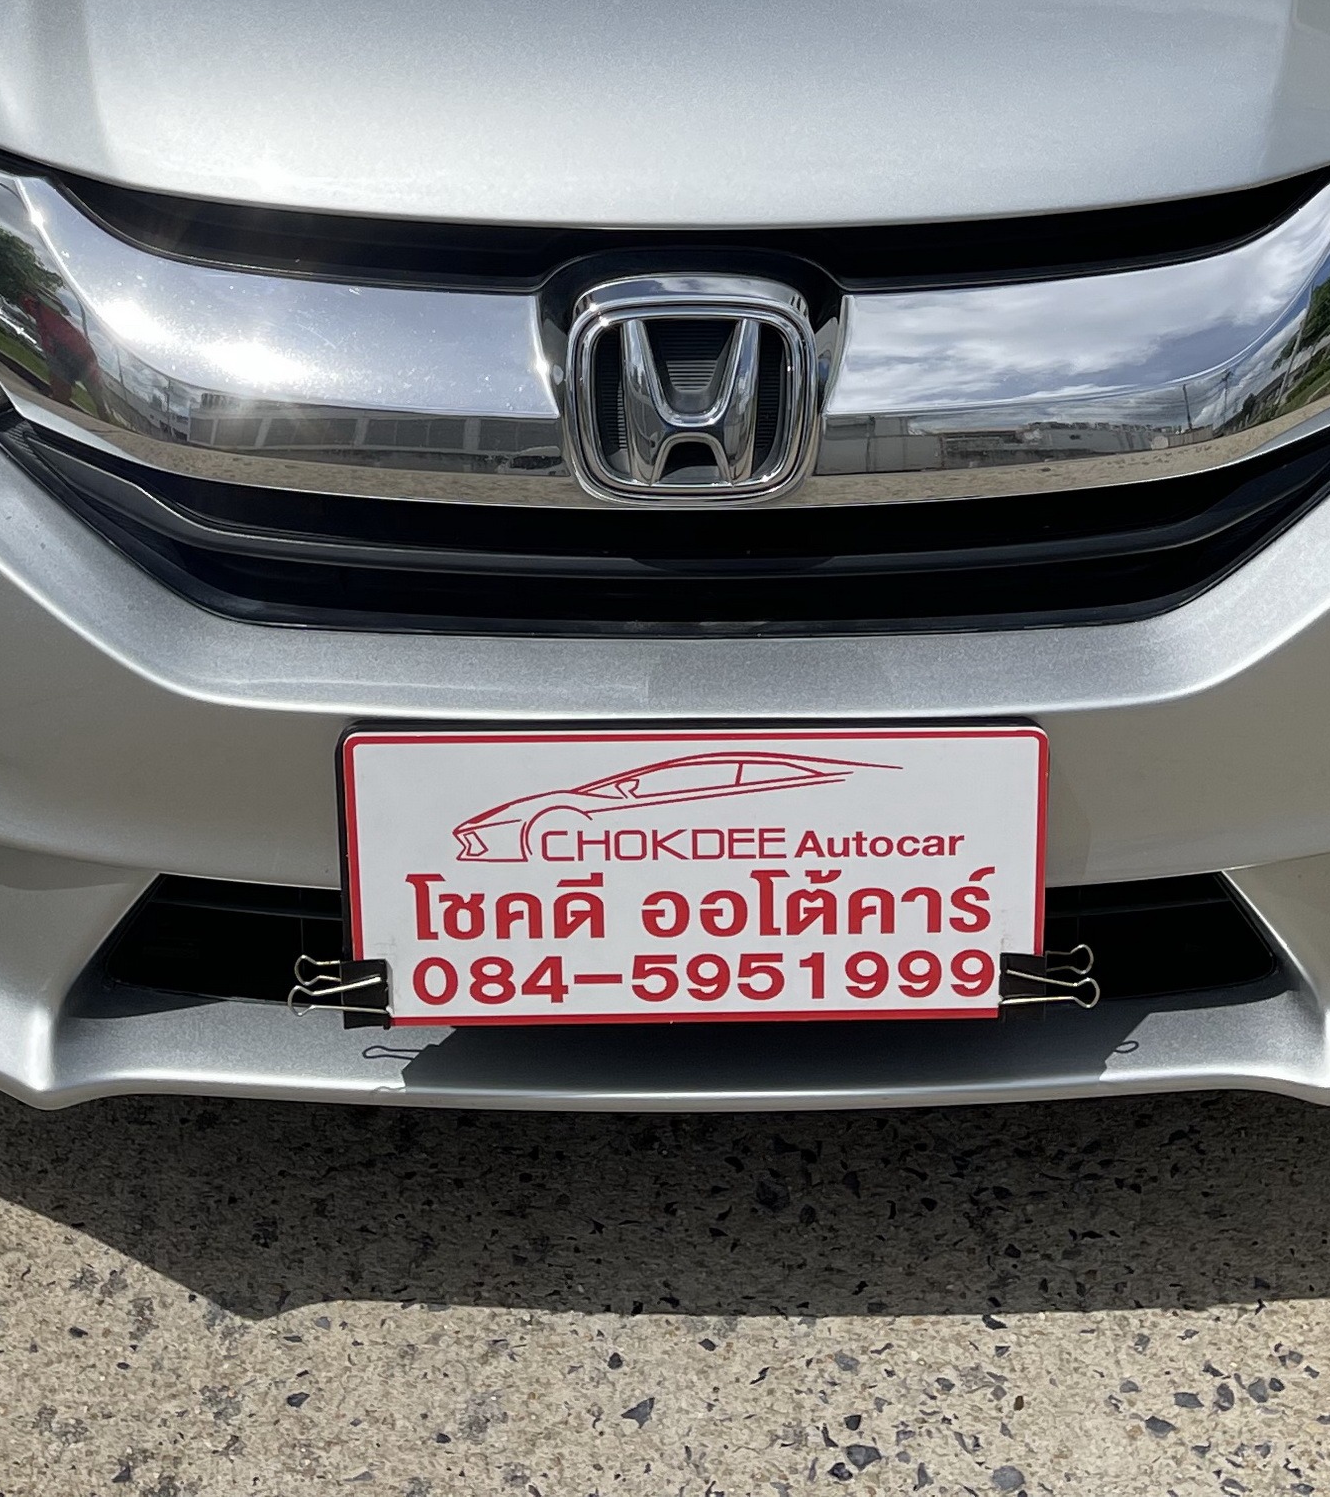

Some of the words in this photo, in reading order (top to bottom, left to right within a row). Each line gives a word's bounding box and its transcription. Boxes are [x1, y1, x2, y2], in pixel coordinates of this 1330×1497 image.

[541, 828, 787, 861] CHOKDEE
[794, 829, 965, 858] Autocar
[406, 873, 605, 940] โชคดี
[642, 866, 996, 938] ออโต้คาร์
[412, 949, 995, 1005] 084-5951999
